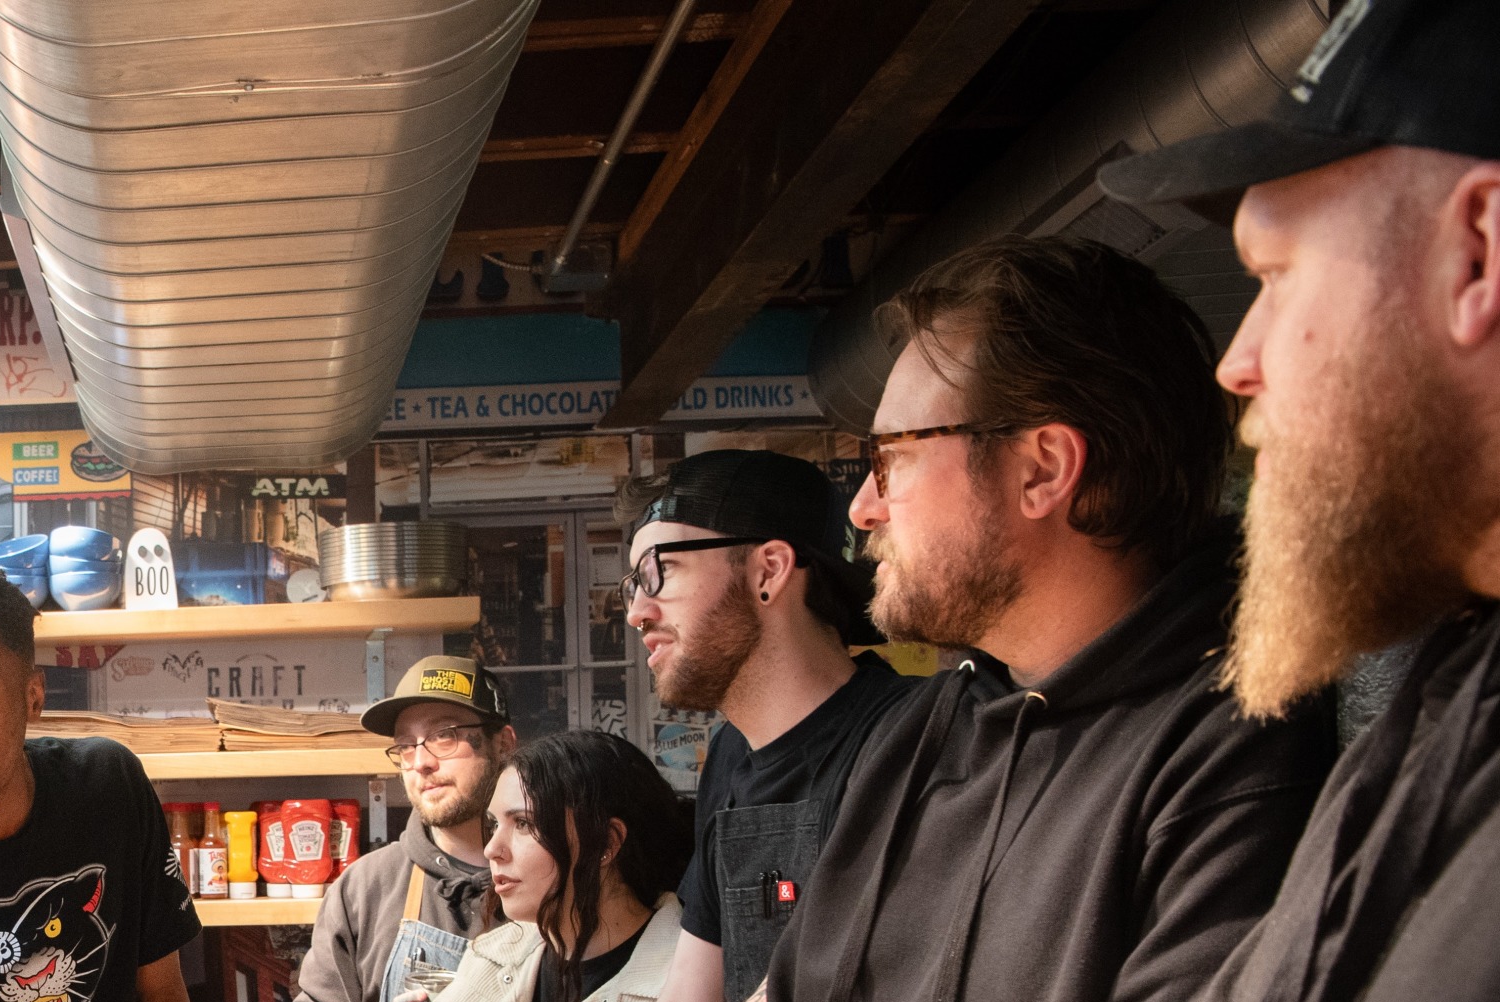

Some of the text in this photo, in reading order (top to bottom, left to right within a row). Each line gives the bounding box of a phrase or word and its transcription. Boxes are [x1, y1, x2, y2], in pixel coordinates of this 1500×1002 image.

[426, 395, 469, 419] TEA
[476, 394, 490, 417] &
[498, 389, 621, 417] CHOCOLAT
[715, 384, 794, 408] DRINKS
[22, 444, 55, 457] BEER
[251, 477, 330, 496] ATM
[135, 566, 169, 596] BOO
[207, 665, 306, 698] CRAFT
[423, 676, 455, 685] GHOST
[437, 670, 456, 678] THE
[432, 683, 455, 691] FACE
[655, 732, 705, 752] BLUE MOON
